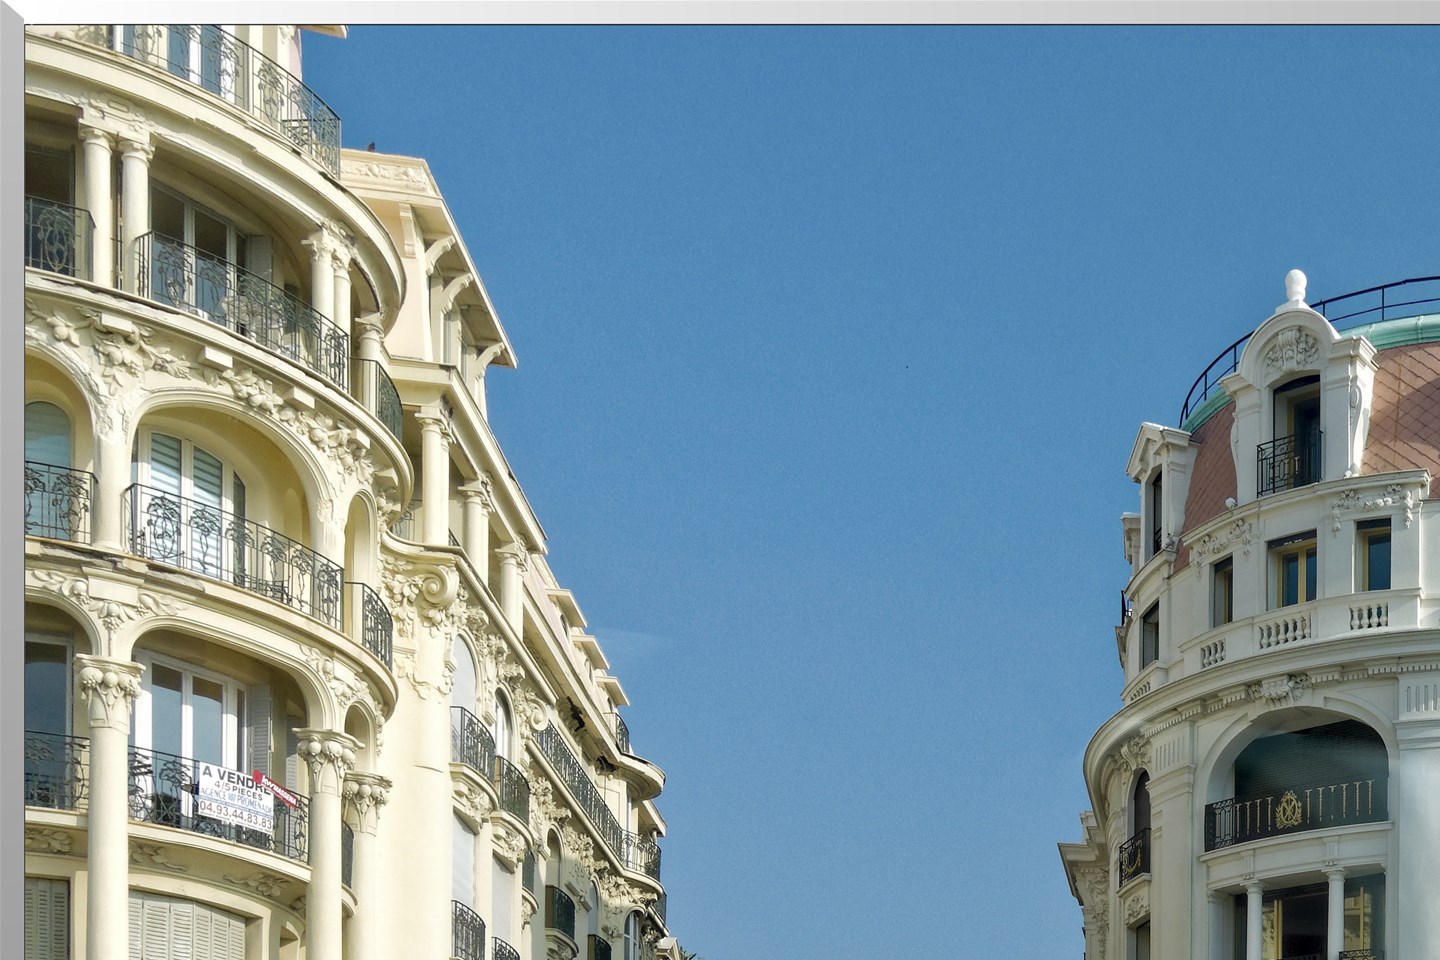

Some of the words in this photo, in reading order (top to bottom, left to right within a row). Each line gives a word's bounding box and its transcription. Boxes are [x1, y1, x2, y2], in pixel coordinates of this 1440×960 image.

[202, 765, 213, 777] A
[201, 788, 227, 801] AGENCE
[232, 785, 263, 801] PIECES
[200, 801, 272, 830] 04.93.44.83.83
